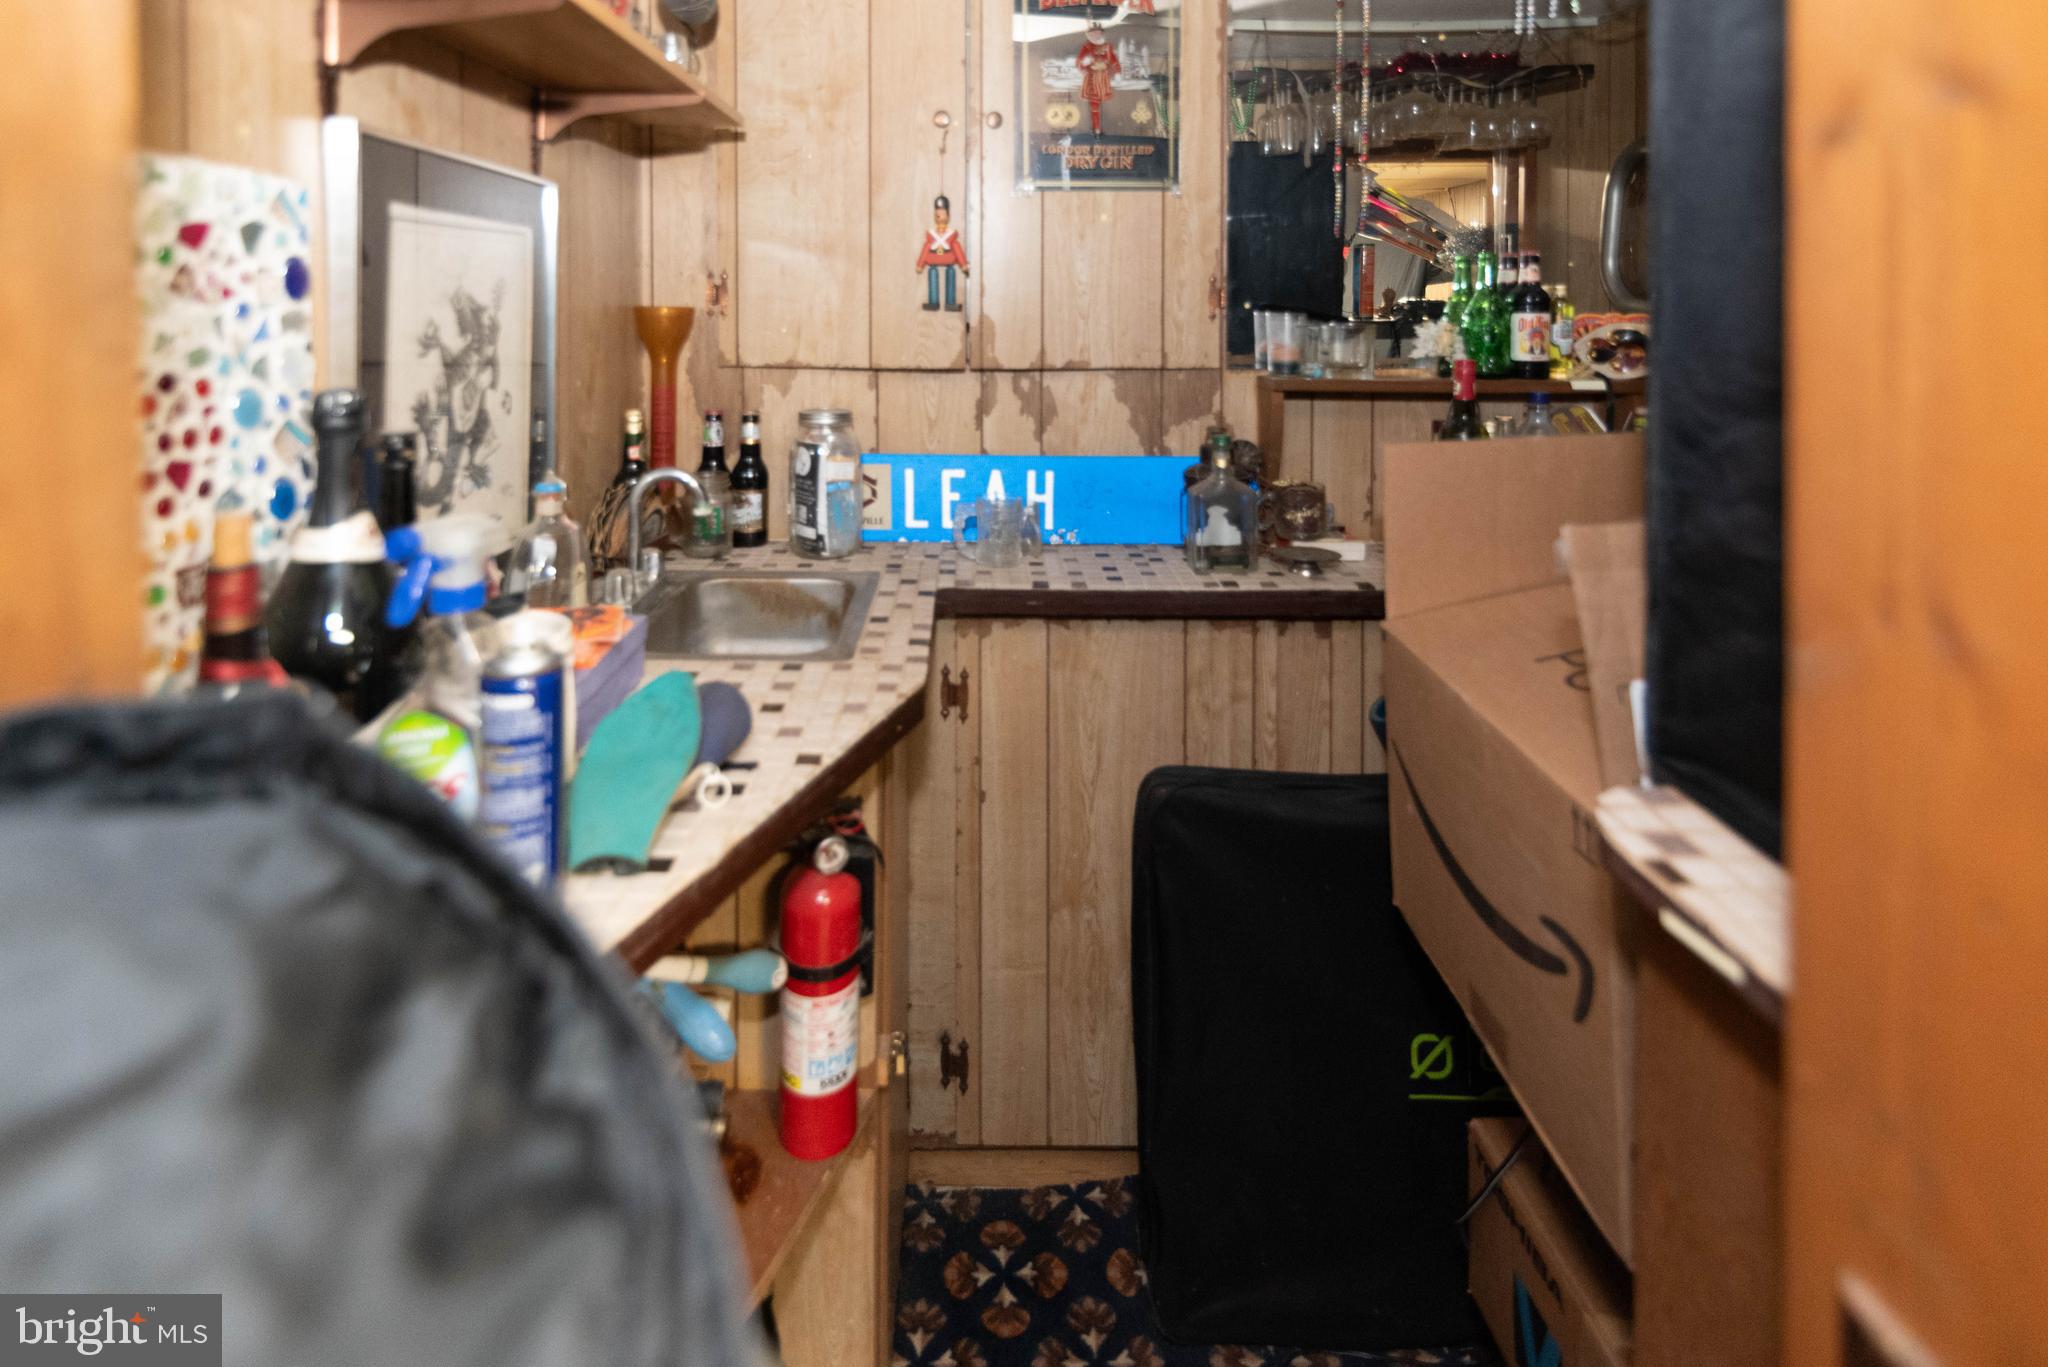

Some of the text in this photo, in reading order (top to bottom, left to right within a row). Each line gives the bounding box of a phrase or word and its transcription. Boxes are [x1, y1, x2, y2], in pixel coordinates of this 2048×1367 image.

[1093, 145, 1154, 155] DISTILLED
[1066, 156, 1134, 169] DRY GIN
[903, 467, 1055, 531] LEAH
